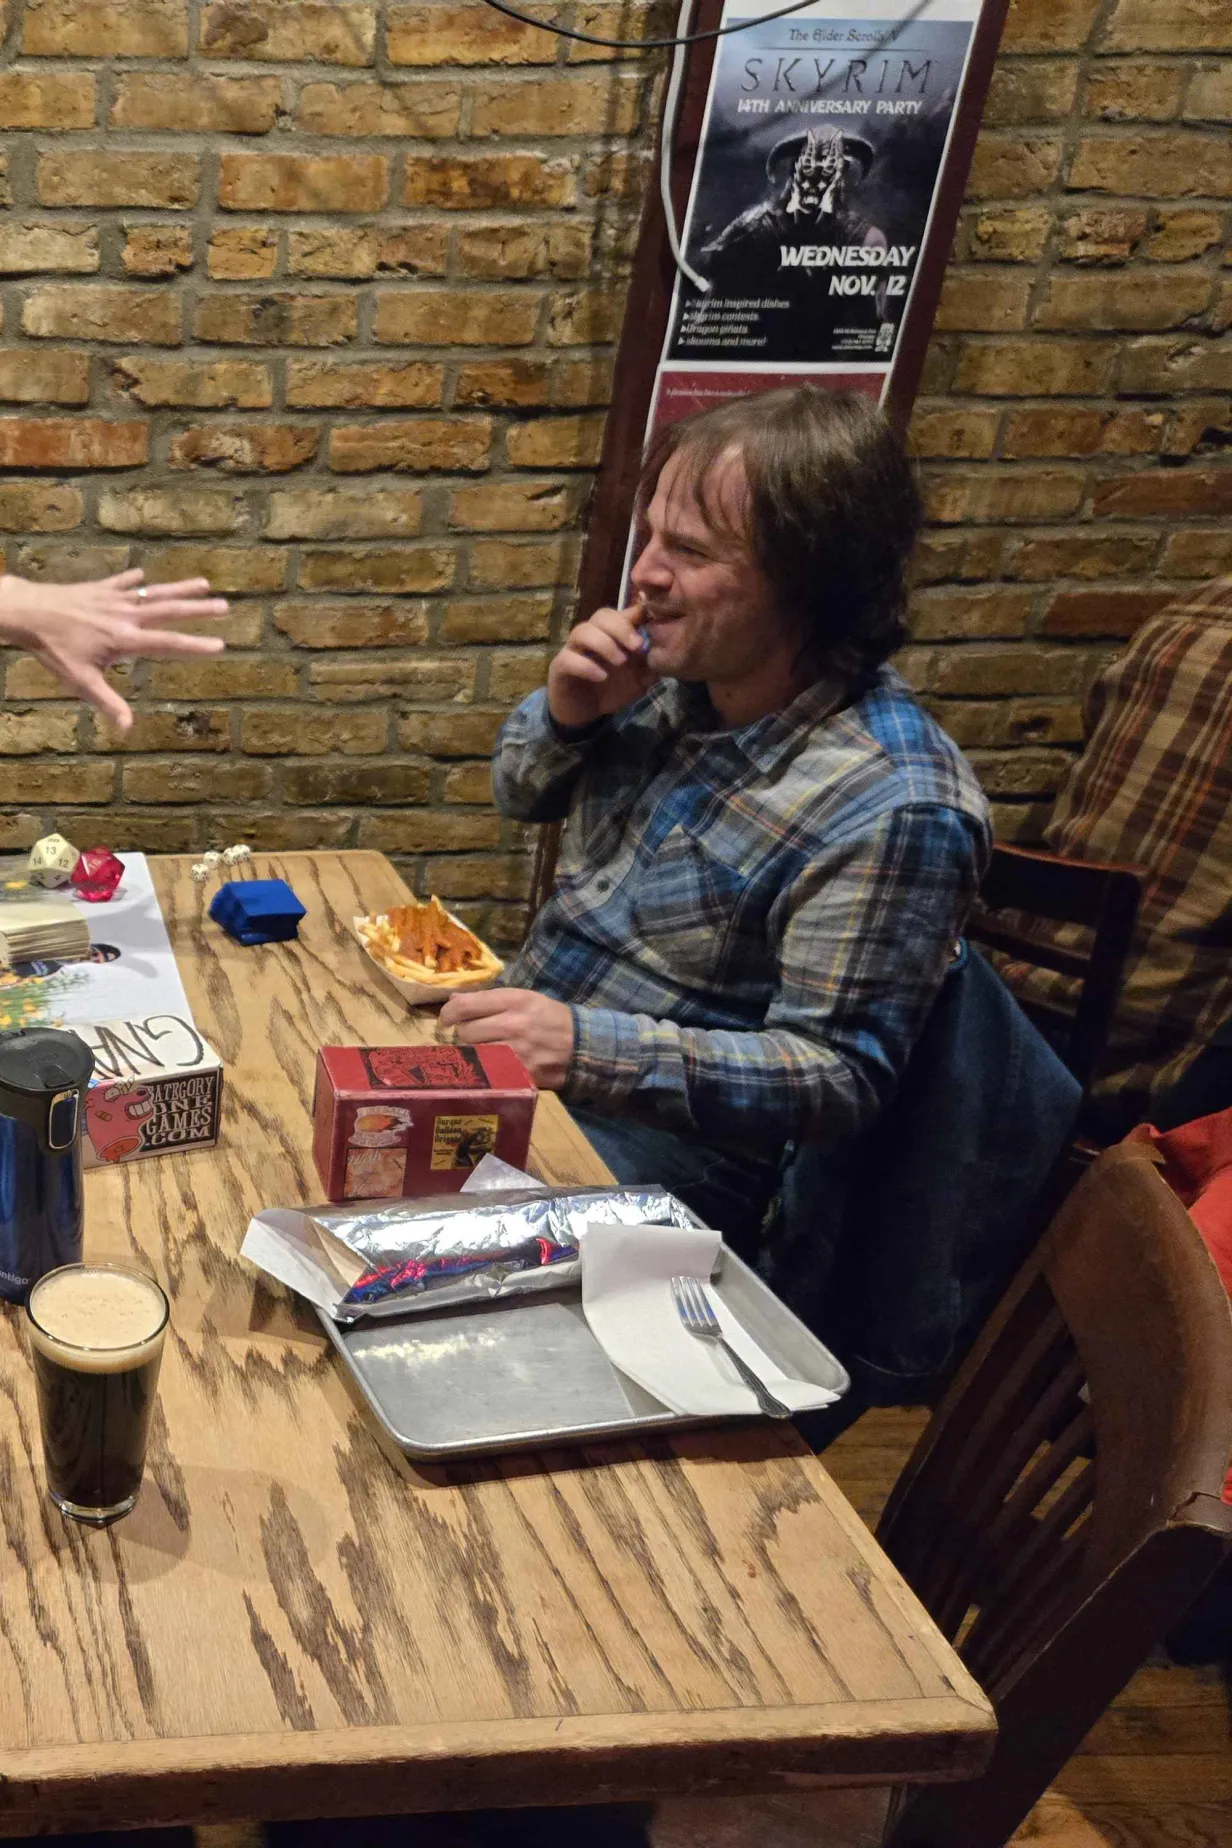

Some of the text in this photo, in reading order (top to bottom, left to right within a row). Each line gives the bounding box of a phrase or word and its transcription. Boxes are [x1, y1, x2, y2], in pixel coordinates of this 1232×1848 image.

[789, 28, 808, 41] The
[813, 28, 843, 43] Elder
[846, 28, 885, 43] Scrolls
[740, 57, 933, 94] SKYRIM
[737, 98, 923, 115] 14TH ANNIVERSARY PARTY
[779, 245, 917, 267] WEDNESDAY
[828, 274, 908, 297] NOV. 12
[33, 856, 42, 866] 14
[45, 846, 57, 855] 13
[58, 858, 69, 868] 12
[68, 1014, 205, 1080] GNA
[147, 1076, 215, 1105] CATEGORY
[153, 1094, 213, 1115] ONE
[145, 1106, 212, 1135] GAMES
[144, 1126, 210, 1147] .COM
